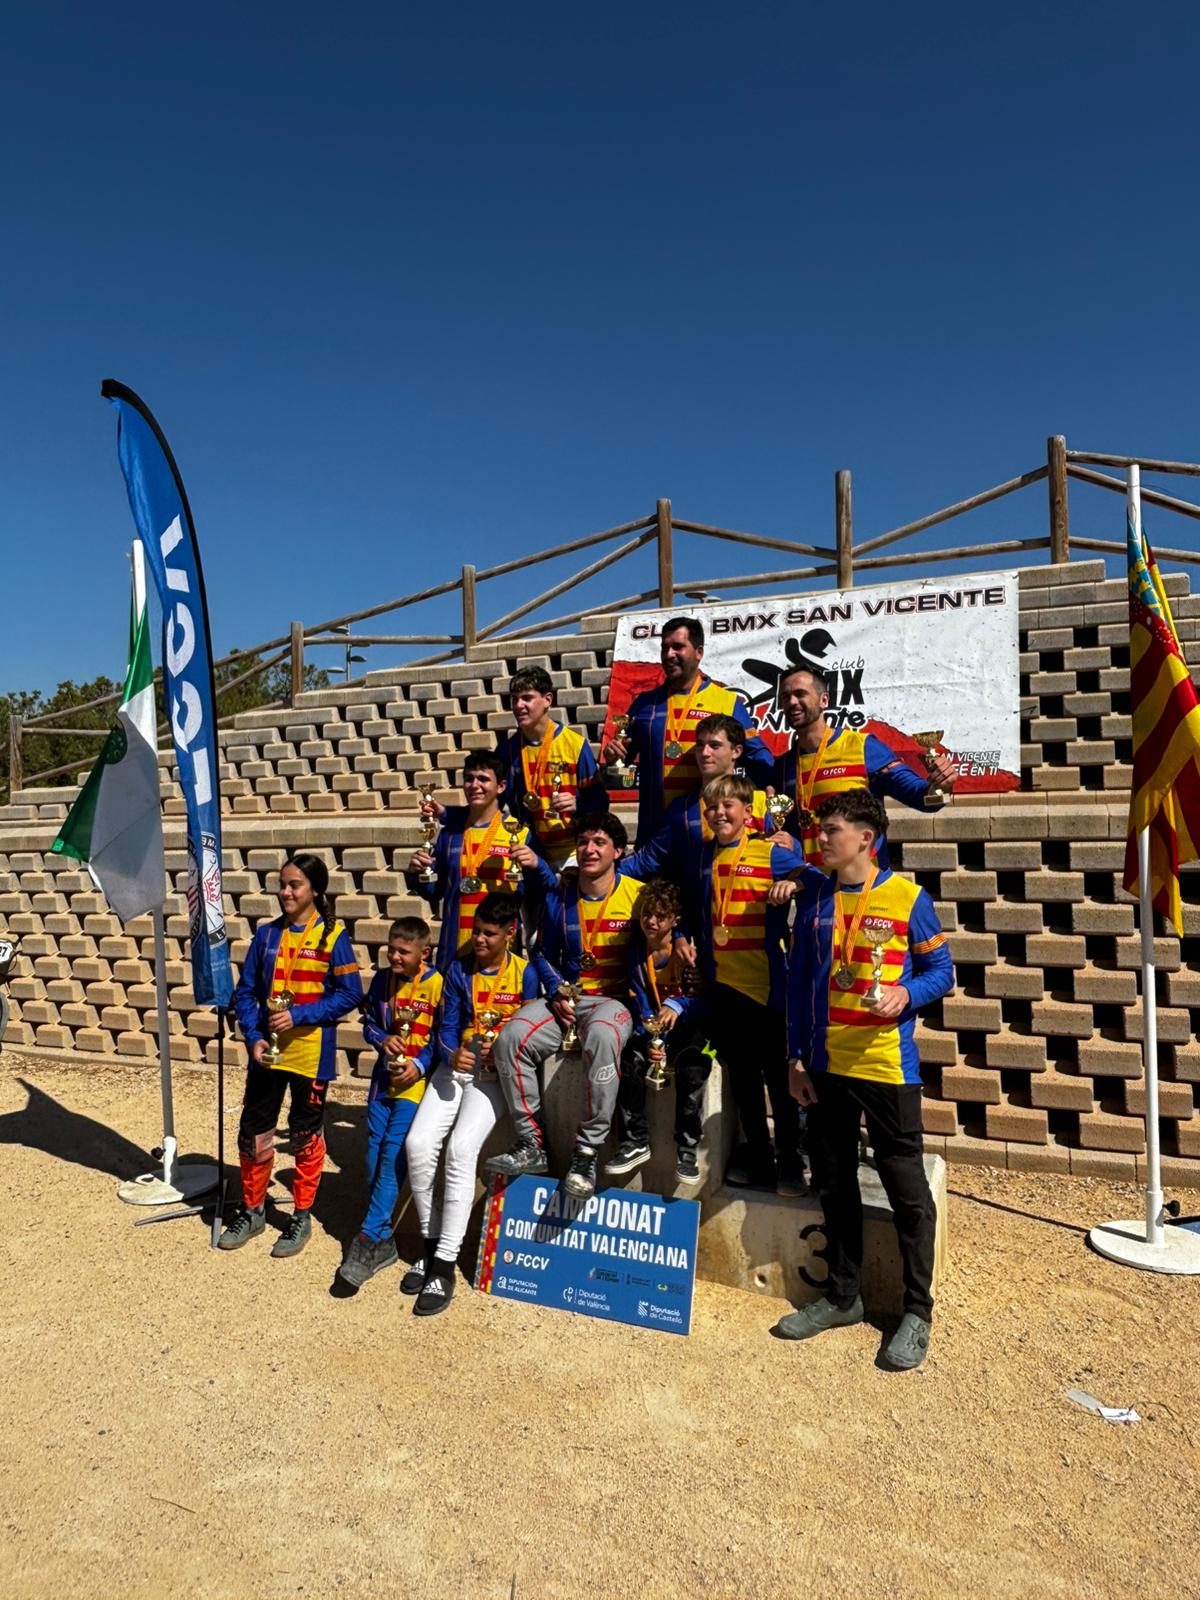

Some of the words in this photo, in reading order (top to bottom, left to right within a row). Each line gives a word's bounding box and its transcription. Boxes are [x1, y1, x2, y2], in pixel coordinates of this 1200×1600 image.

[632, 624, 663, 640] CL
[711, 612, 778, 635] BMX
[786, 604, 852, 626] SAN
[861, 586, 1005, 617] VICENTE
[832, 656, 865, 671] club
[957, 751, 1000, 762] VICENTE
[829, 767, 847, 775] FCCV
[738, 865, 754, 873] FCCV
[872, 919, 893, 929] FCCV
[0, 946, 8, 957] 7
[532, 1187, 667, 1236] CAMPIONAT
[504, 1217, 587, 1250] COMUNITAT
[591, 1232, 689, 1269] VALENCIANA
[515, 1252, 550, 1270] FCCV
[798, 1224, 831, 1289] 3
